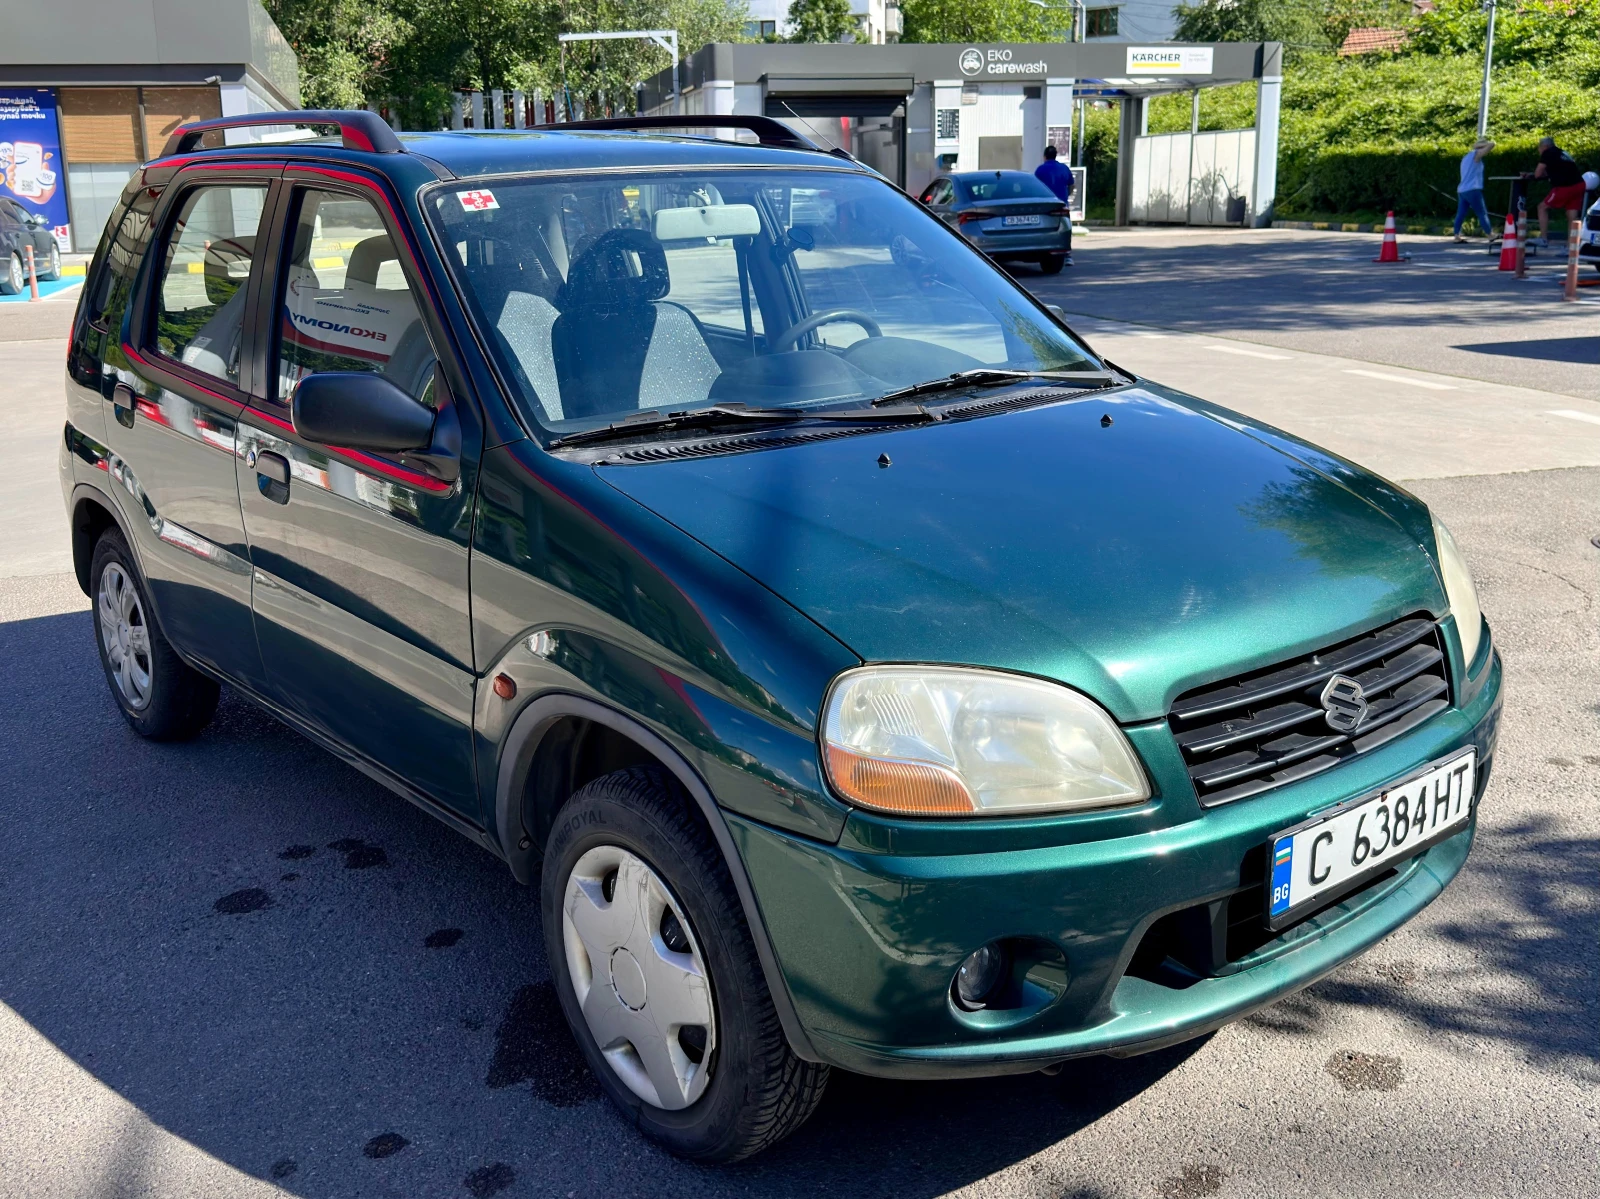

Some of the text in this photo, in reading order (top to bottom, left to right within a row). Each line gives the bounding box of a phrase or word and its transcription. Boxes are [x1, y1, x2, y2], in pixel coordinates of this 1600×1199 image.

[987, 49, 1012, 61] EKO
[987, 60, 1047, 74] carewash
[1309, 830, 1333, 886] C
[1273, 883, 1289, 904] BG
